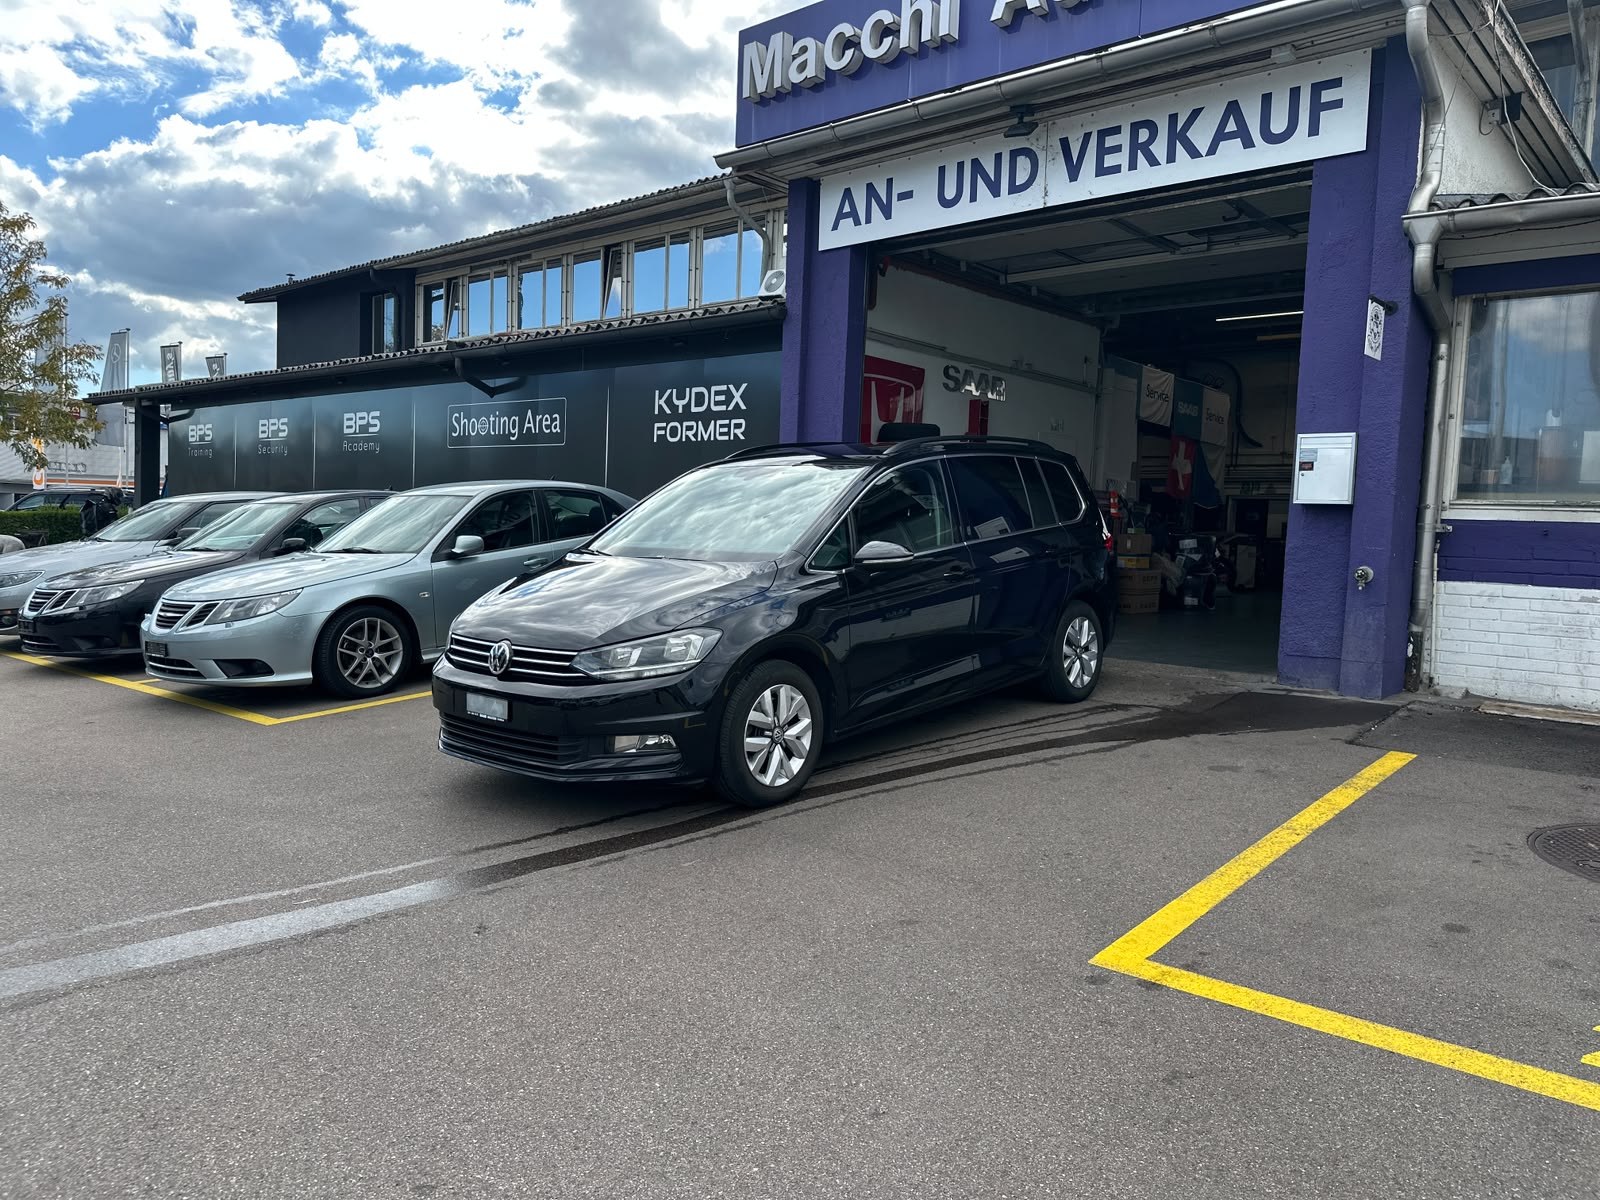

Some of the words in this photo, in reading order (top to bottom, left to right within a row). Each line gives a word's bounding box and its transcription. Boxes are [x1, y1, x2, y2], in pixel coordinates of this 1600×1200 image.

[831, 176, 914, 231] AN-
[937, 145, 1039, 208] UND
[1059, 76, 1344, 183] VERKAUF
[942, 364, 1006, 402] SAAB
[654, 382, 748, 415] KYDEX
[188, 423, 213, 442] BPS
[258, 417, 288, 438] BPS
[343, 410, 381, 434] BPS
[523, 409, 561, 434] Area
[653, 418, 746, 443] FORMER
[187, 447, 213, 459] Training
[257, 443, 288, 456] Security
[342, 440, 380, 454] Academy
